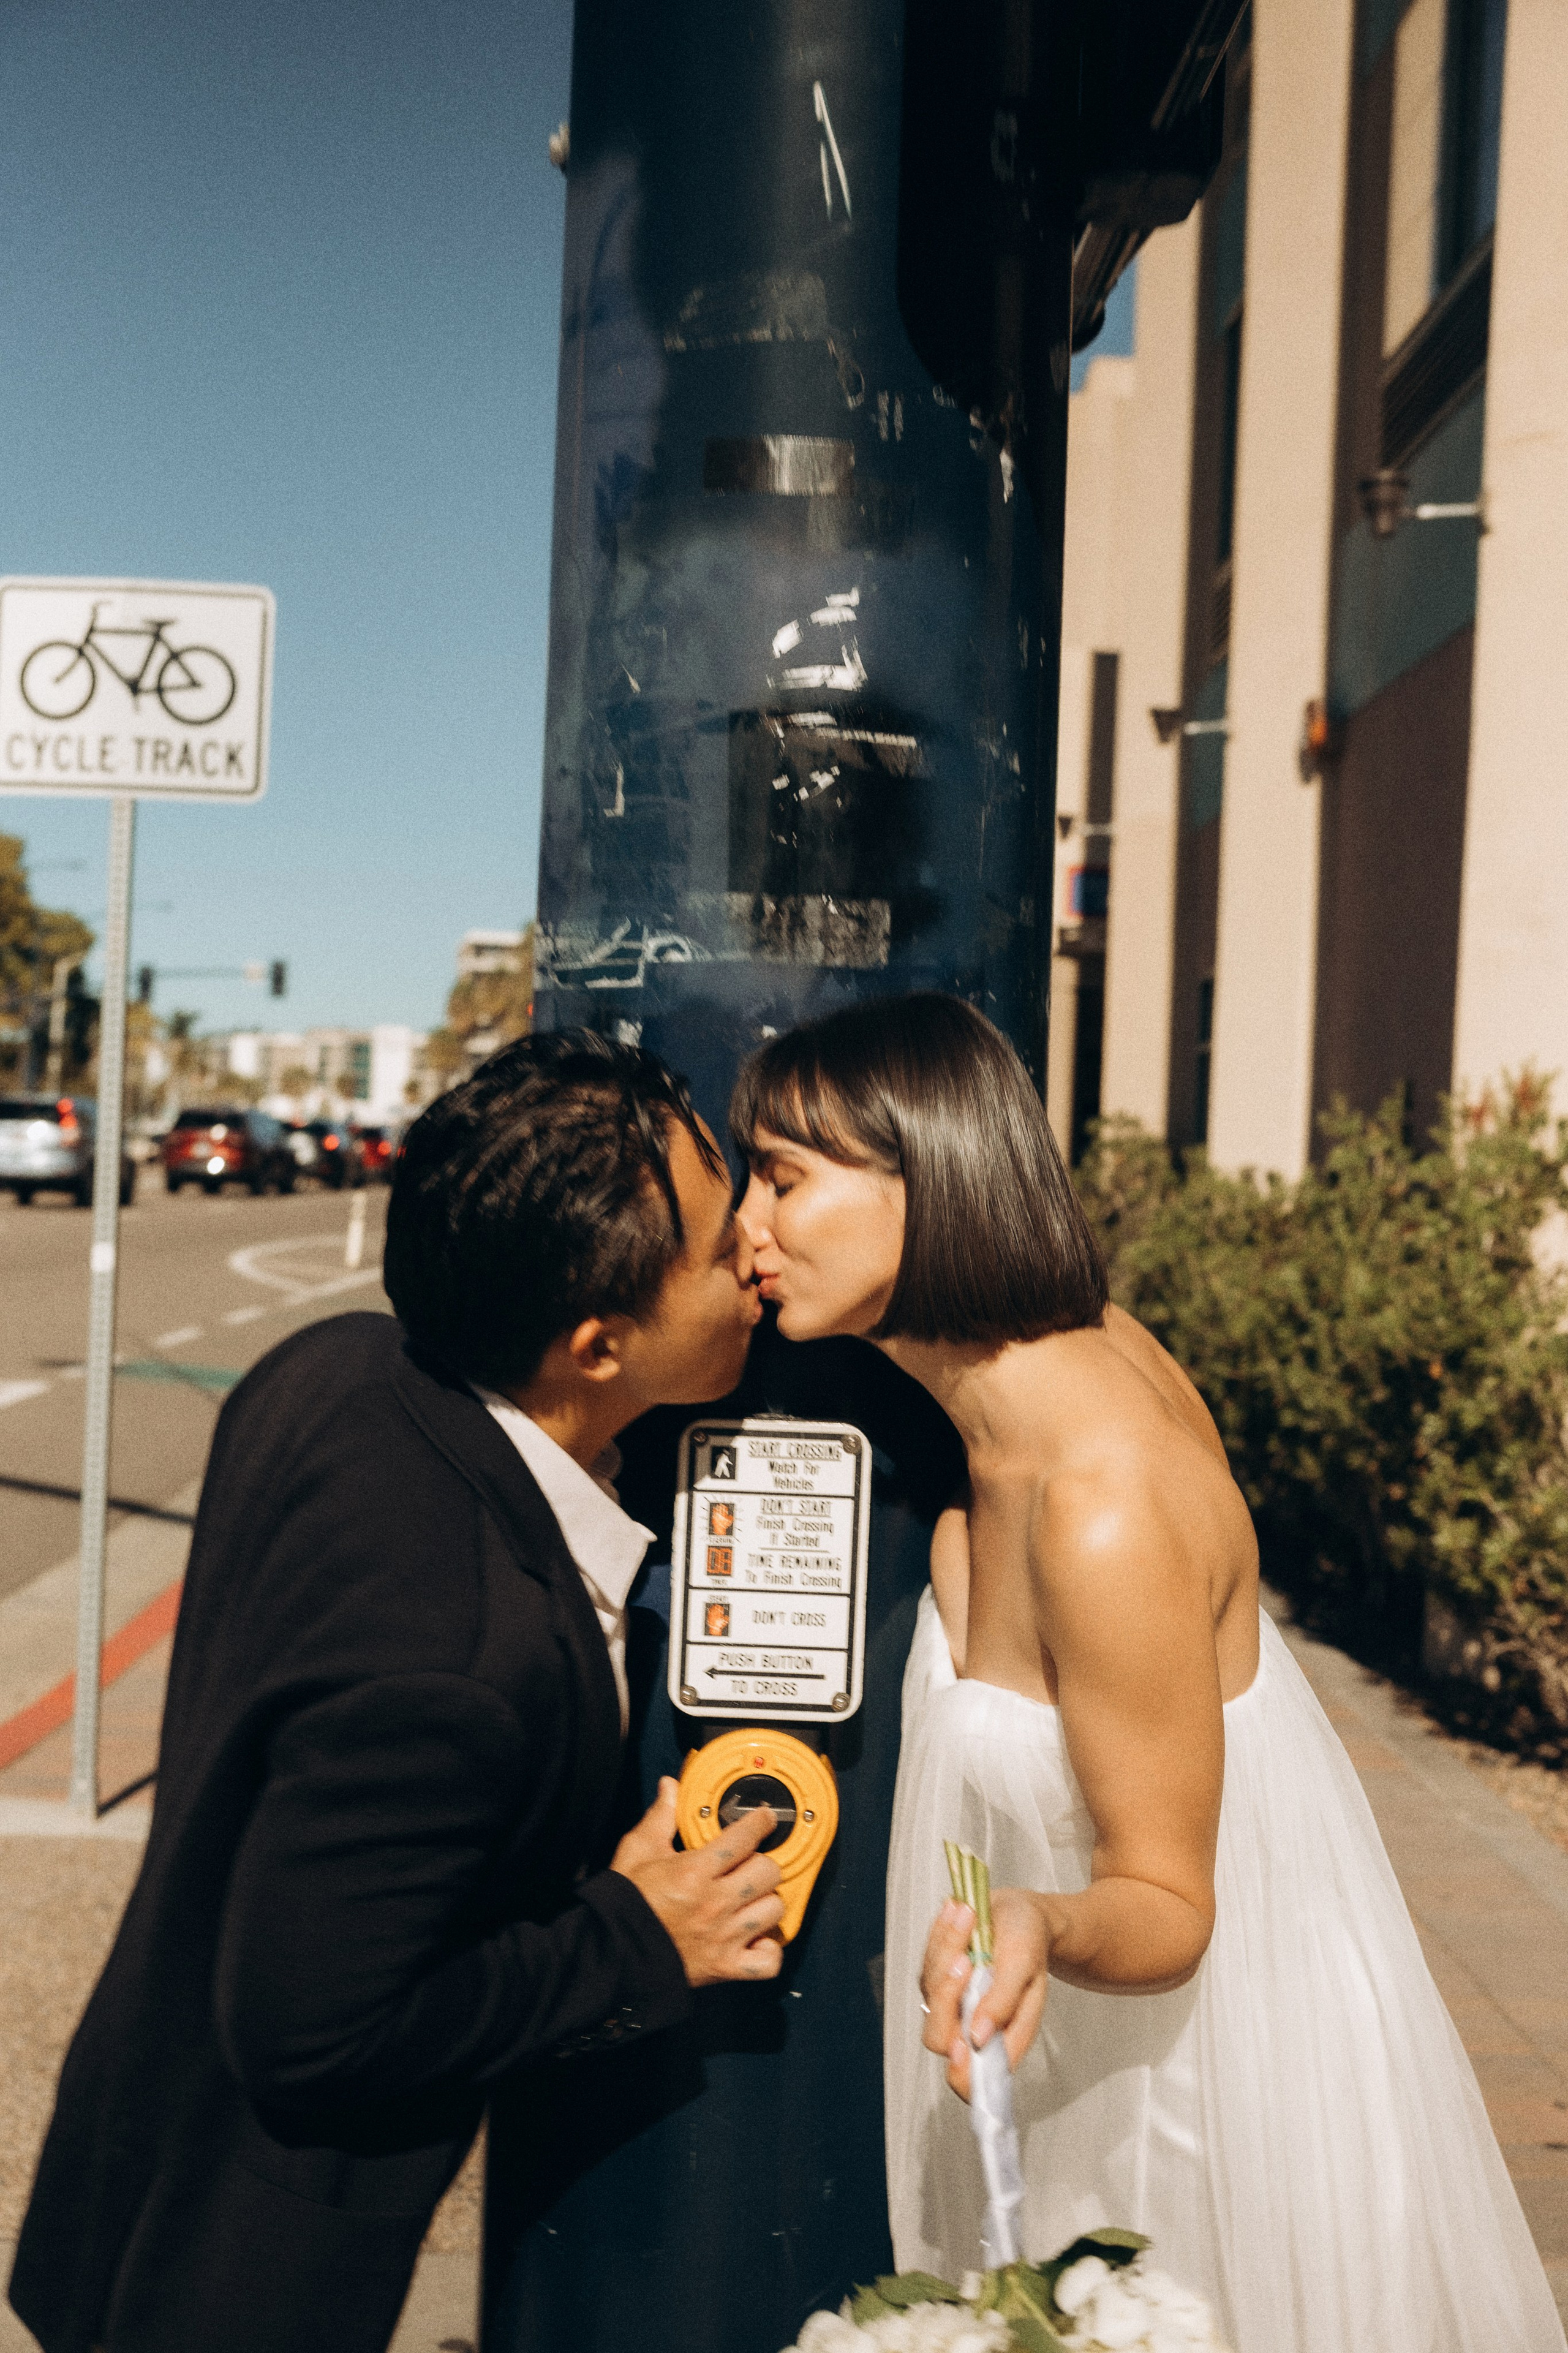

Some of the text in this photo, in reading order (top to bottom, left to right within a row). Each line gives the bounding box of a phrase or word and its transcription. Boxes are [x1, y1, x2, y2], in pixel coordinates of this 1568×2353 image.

[4, 731, 246, 778] CYCLE TRACK
[748, 1441, 841, 1459] START CROSSING
[769, 1460, 820, 1475] Watch For
[774, 1475, 814, 1490] Vehicles
[761, 1498, 831, 1516] DON'T START
[756, 1516, 834, 1536] Finish Crossing
[783, 1533, 819, 1547] Started
[748, 1553, 842, 1571] TIME REMAINING
[764, 1571, 793, 1585] Finish
[800, 1572, 842, 1592] Crossing
[753, 1610, 826, 1626] DON'T CROSS
[718, 1653, 813, 1670] PUSH BUTTON
[732, 1680, 797, 1696] TO CROSS
